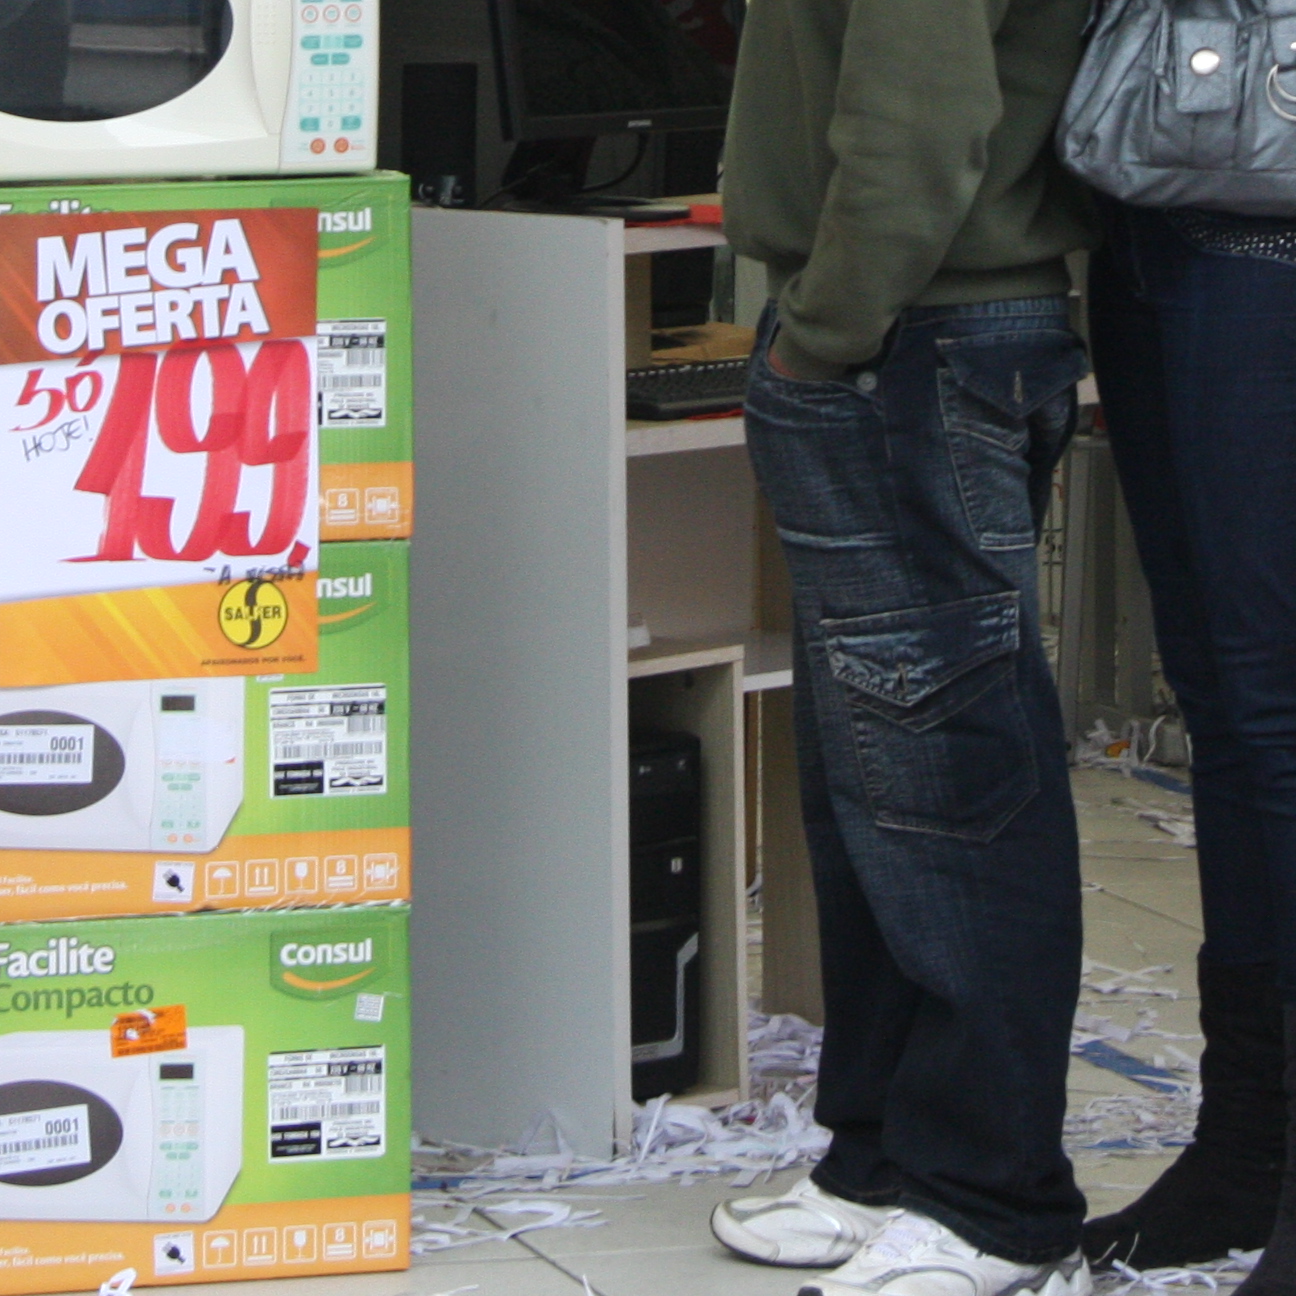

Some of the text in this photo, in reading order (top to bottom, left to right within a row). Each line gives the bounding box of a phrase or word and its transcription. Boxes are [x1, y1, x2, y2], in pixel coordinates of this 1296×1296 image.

[36, 218, 259, 302] MEGA
[37, 281, 270, 355] OFERTA
[22, 417, 94, 462] HOJE!
[50, 736, 84, 751] 0001
[280, 938, 373, 966] Consul
[45, 1117, 79, 1135] 0001
